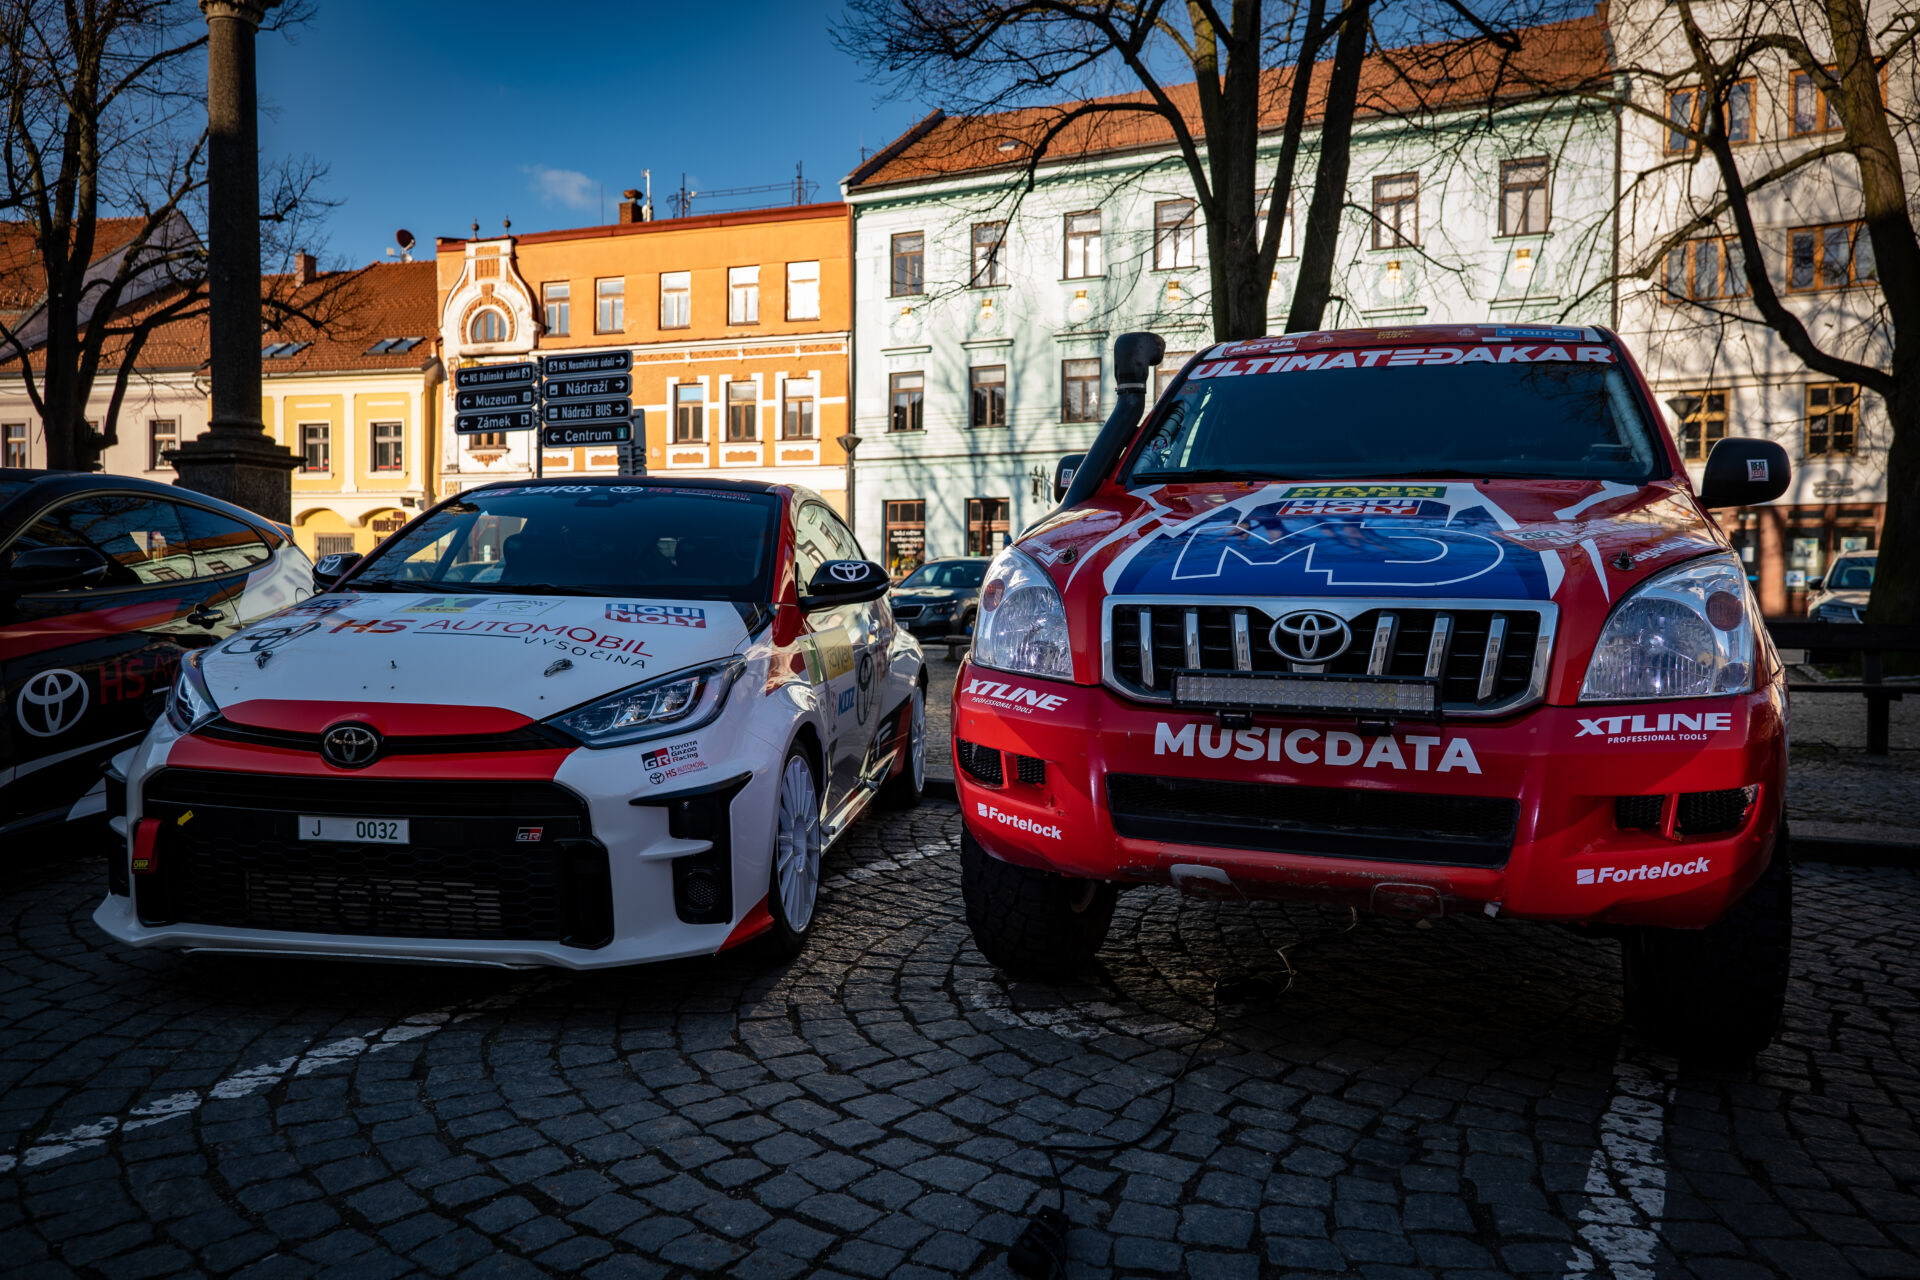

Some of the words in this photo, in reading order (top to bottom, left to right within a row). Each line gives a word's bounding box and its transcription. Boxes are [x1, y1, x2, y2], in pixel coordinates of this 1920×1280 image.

[1500, 329, 1576, 338] aramco
[1230, 340, 1295, 353] MOTUL
[566, 380, 608, 395] Nádraží
[475, 395, 517, 407] Muzeum
[561, 405, 592, 418] Nádraží
[595, 404, 612, 416] BUS
[477, 415, 511, 428] Zámek
[564, 430, 612, 442] Centrum
[522, 485, 599, 494] YARIS
[1284, 506, 1406, 514] MOLY
[607, 603, 702, 618] LIQUI
[605, 614, 701, 628] MOLY
[328, 619, 416, 634] HS
[420, 619, 654, 658] AUTOMOBIL
[523, 636, 646, 669] VYSOČINA
[100, 658, 146, 705] HS
[960, 678, 1069, 712] XTLINE
[971, 696, 1012, 710] PROFESSIONAL
[1012, 704, 1034, 715] TOOLS
[1574, 712, 1732, 738] XTLINE
[1607, 735, 1676, 744] PROFESSIONAL
[1678, 733, 1708, 741] TOOLS
[669, 740, 698, 752] TOYOTA
[670, 746, 697, 757] GAZOO
[1153, 721, 1483, 775] MUSICDATA
[643, 755, 671, 771] GR
[672, 752, 699, 763] Racing
[665, 768, 677, 779] HS
[311, 819, 322, 837] J
[355, 820, 399, 840] 0032
[988, 805, 1063, 841] Fortelock
[517, 831, 541, 841] GR
[1596, 856, 1711, 884] Fortelock
